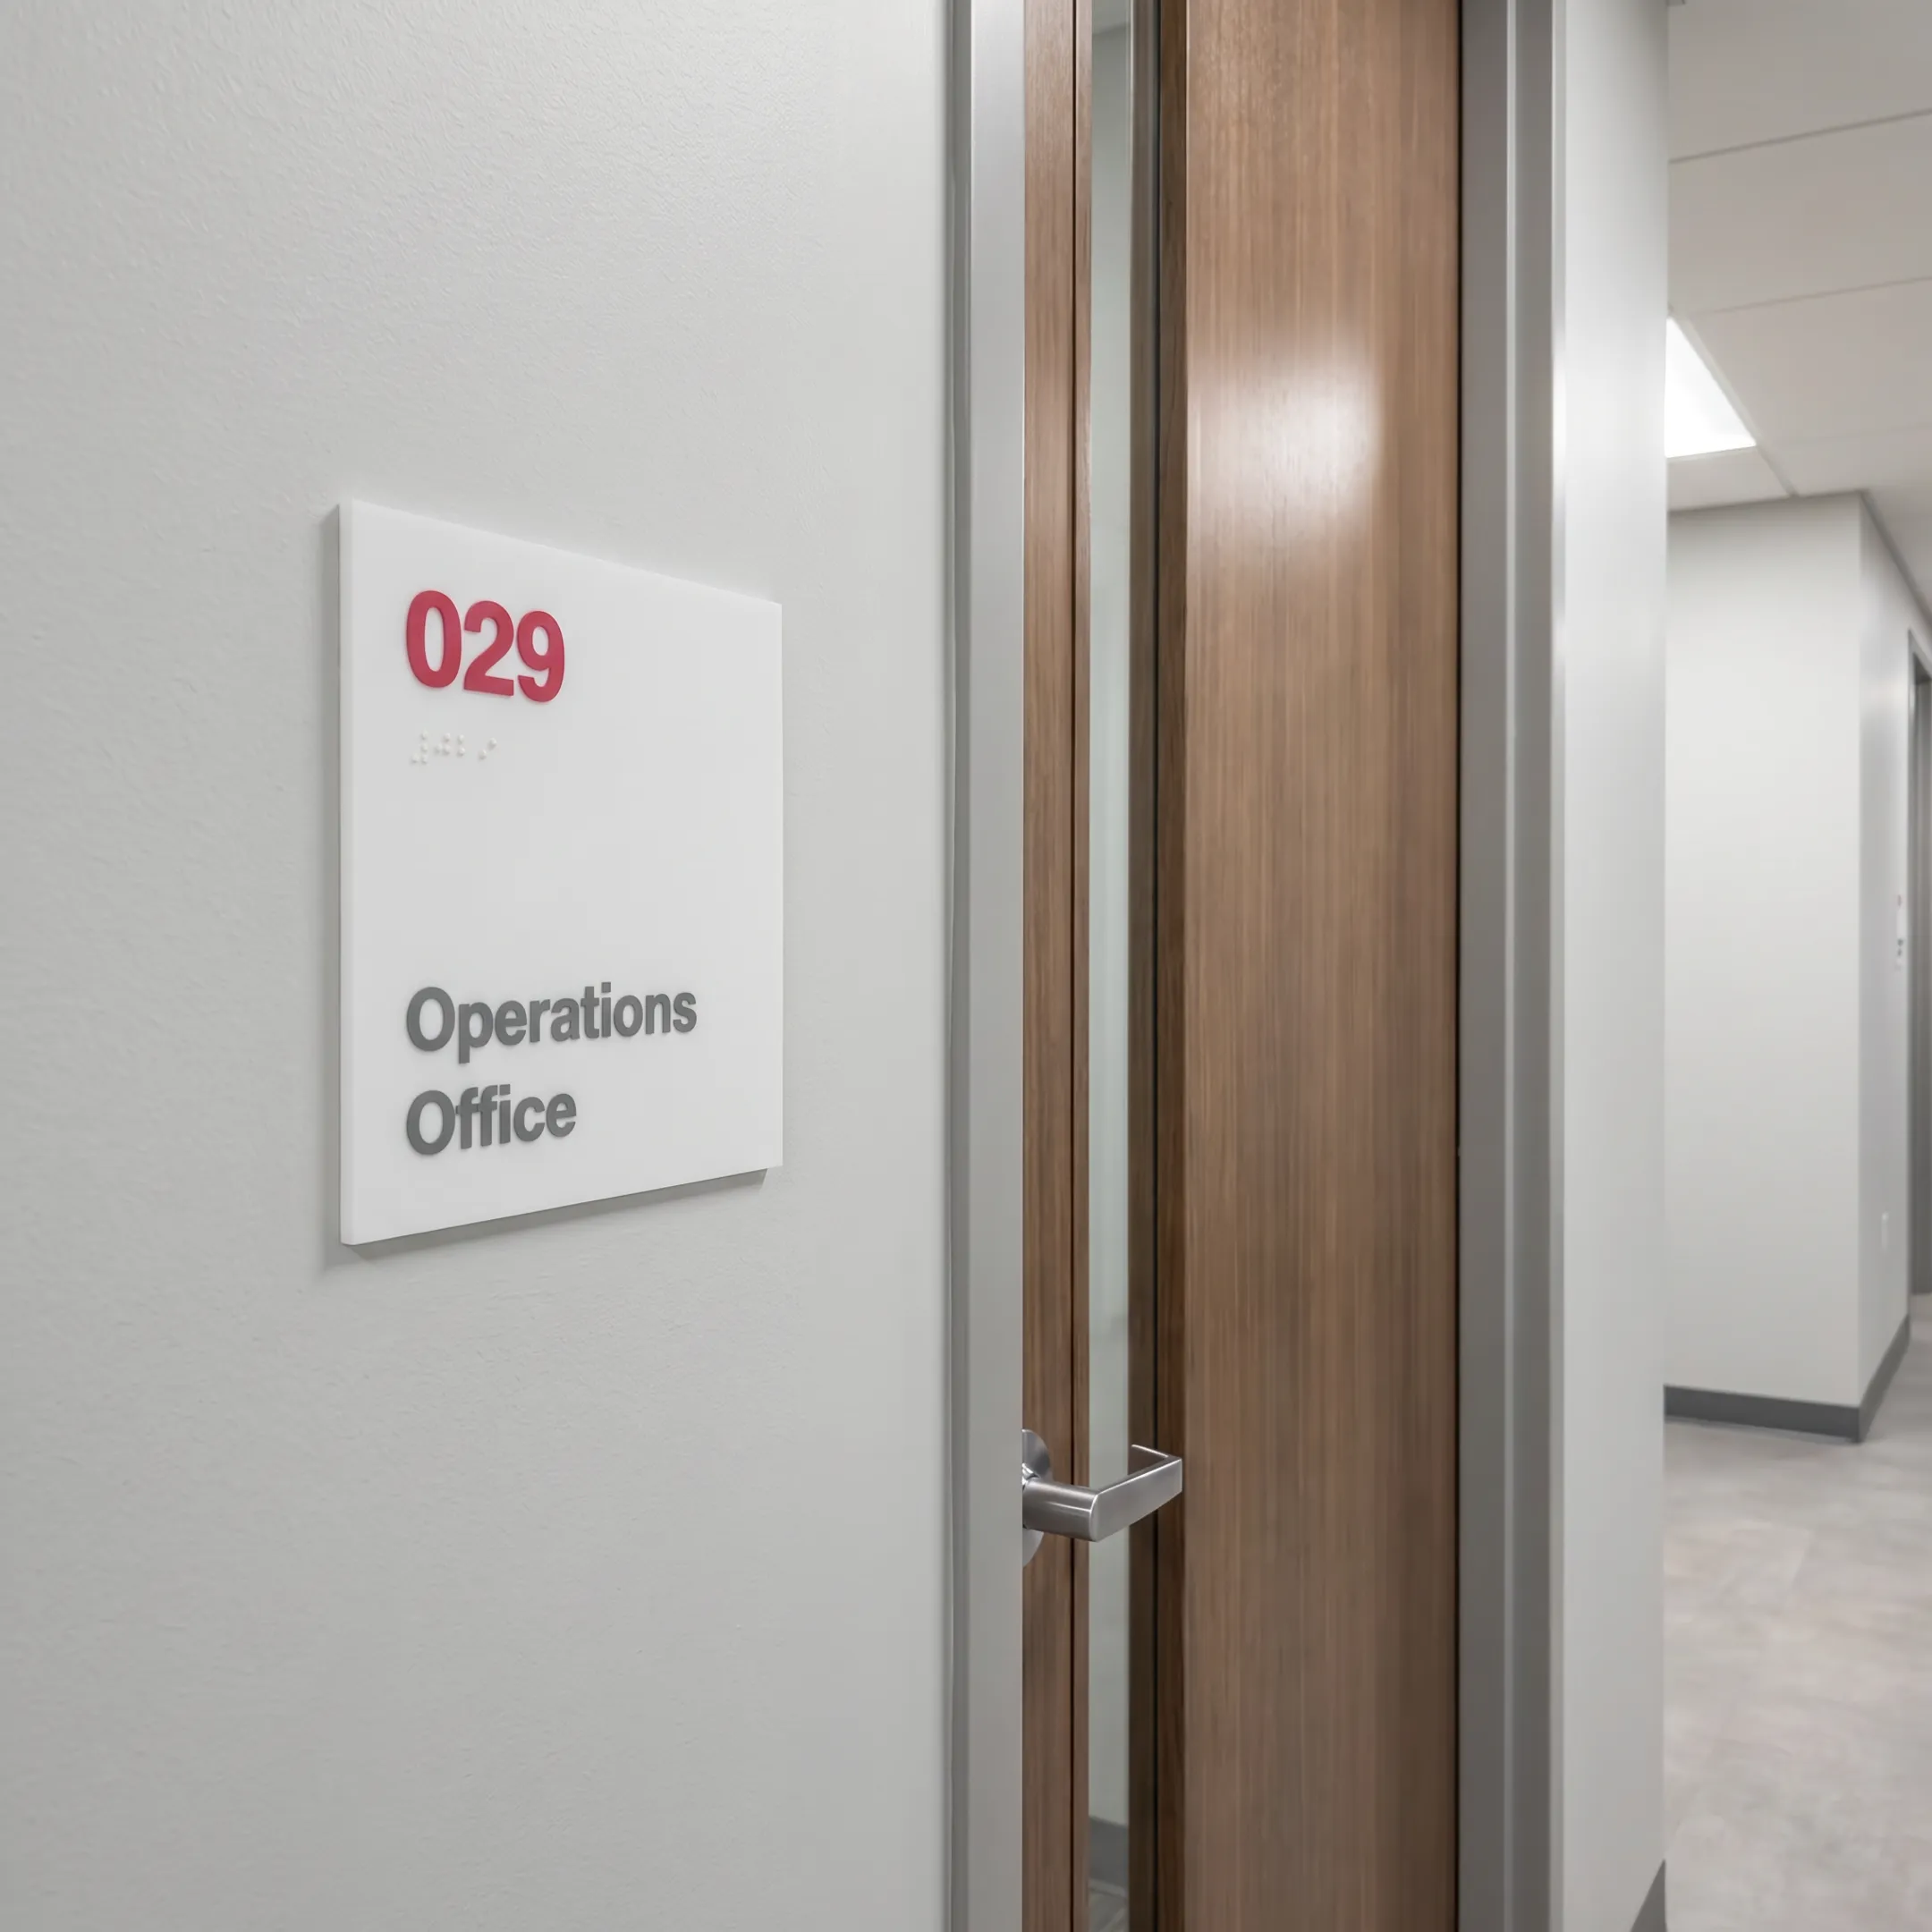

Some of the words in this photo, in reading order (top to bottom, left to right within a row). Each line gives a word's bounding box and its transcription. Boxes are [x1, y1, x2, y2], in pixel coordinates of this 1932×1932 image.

[405, 589, 565, 704] 029
[405, 981, 698, 1065] Operations
[405, 1083, 577, 1157] Office
